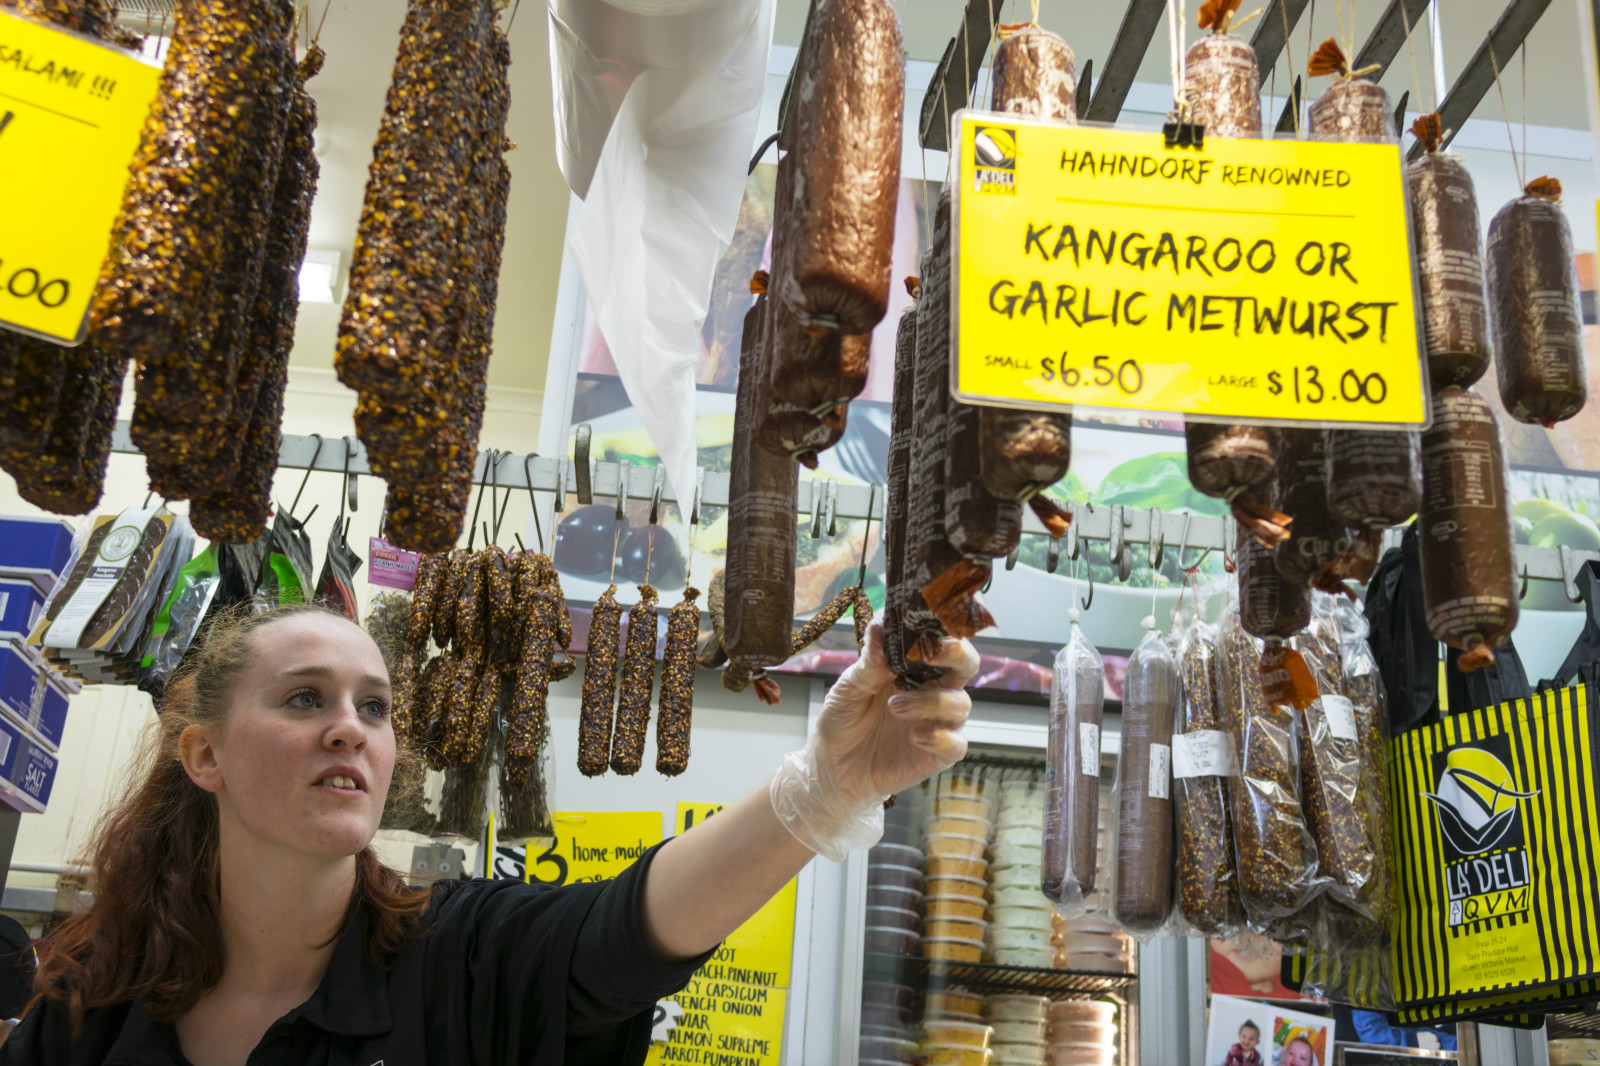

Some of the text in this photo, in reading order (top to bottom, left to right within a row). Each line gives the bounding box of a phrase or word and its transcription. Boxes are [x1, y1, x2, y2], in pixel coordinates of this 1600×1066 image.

[1060, 150, 1352, 188] HAHNDORF RENOWNED
[1024, 222, 1277, 277] KANGAROO
[1295, 241, 1359, 284] OR
[988, 280, 1399, 344] GARLIC METWURST
[984, 351, 1144, 394] SMALL $6.50
[1207, 374, 1258, 389] LARGE
[25, 763, 47, 789] SALT
[1464, 888, 1527, 920] QVM
[1475, 940, 1490, 950] Shop
[1482, 948, 1505, 958] Produce
[1507, 945, 1519, 953] Hall
[1481, 960, 1504, 969] Victoria
[1504, 955, 1527, 965] Market
[706, 982, 768, 1003] CAPSICUM
[722, 1001, 763, 1017] ONION
[716, 1034, 771, 1056] SUPREME
